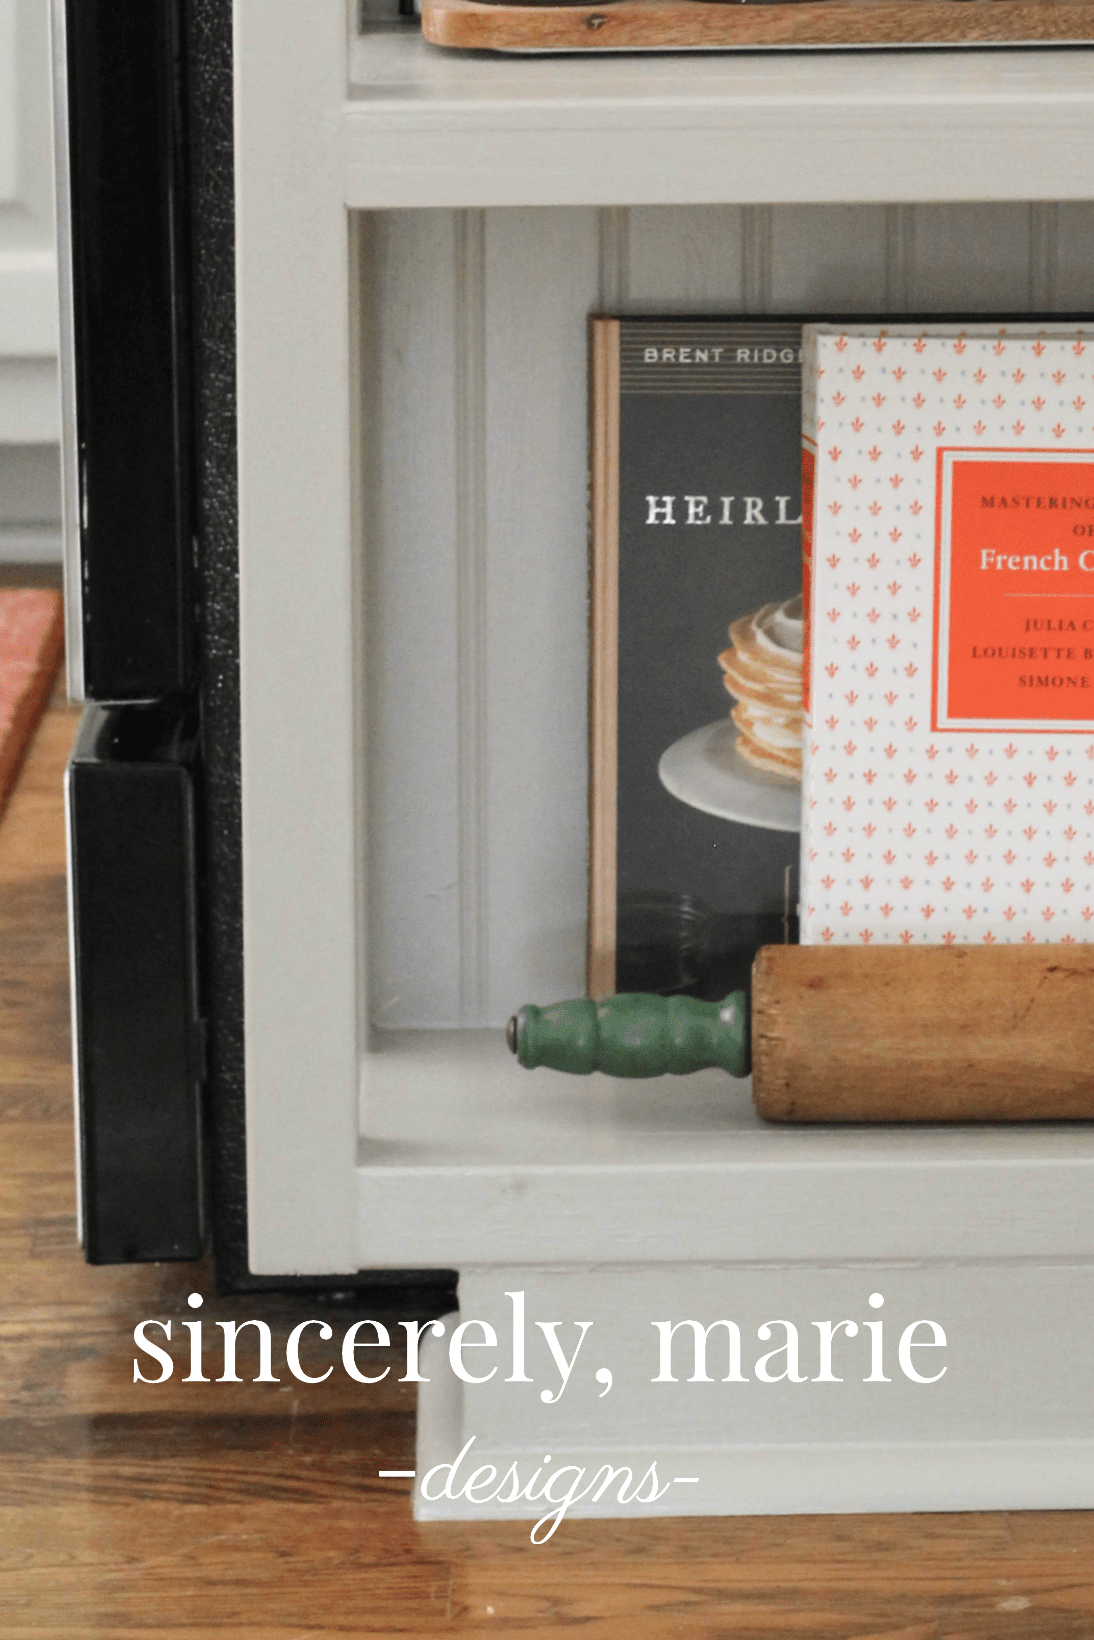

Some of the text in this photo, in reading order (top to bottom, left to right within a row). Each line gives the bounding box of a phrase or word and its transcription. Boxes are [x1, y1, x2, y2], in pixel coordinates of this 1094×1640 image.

[643, 347, 803, 364] BRENT RIDG
[645, 495, 803, 525] HEIRL
[979, 547, 1069, 571] French
[1024, 618, 1077, 633] JULIA
[971, 646, 1079, 660] LOUISETTE
[1018, 675, 1089, 689] SIMONE
